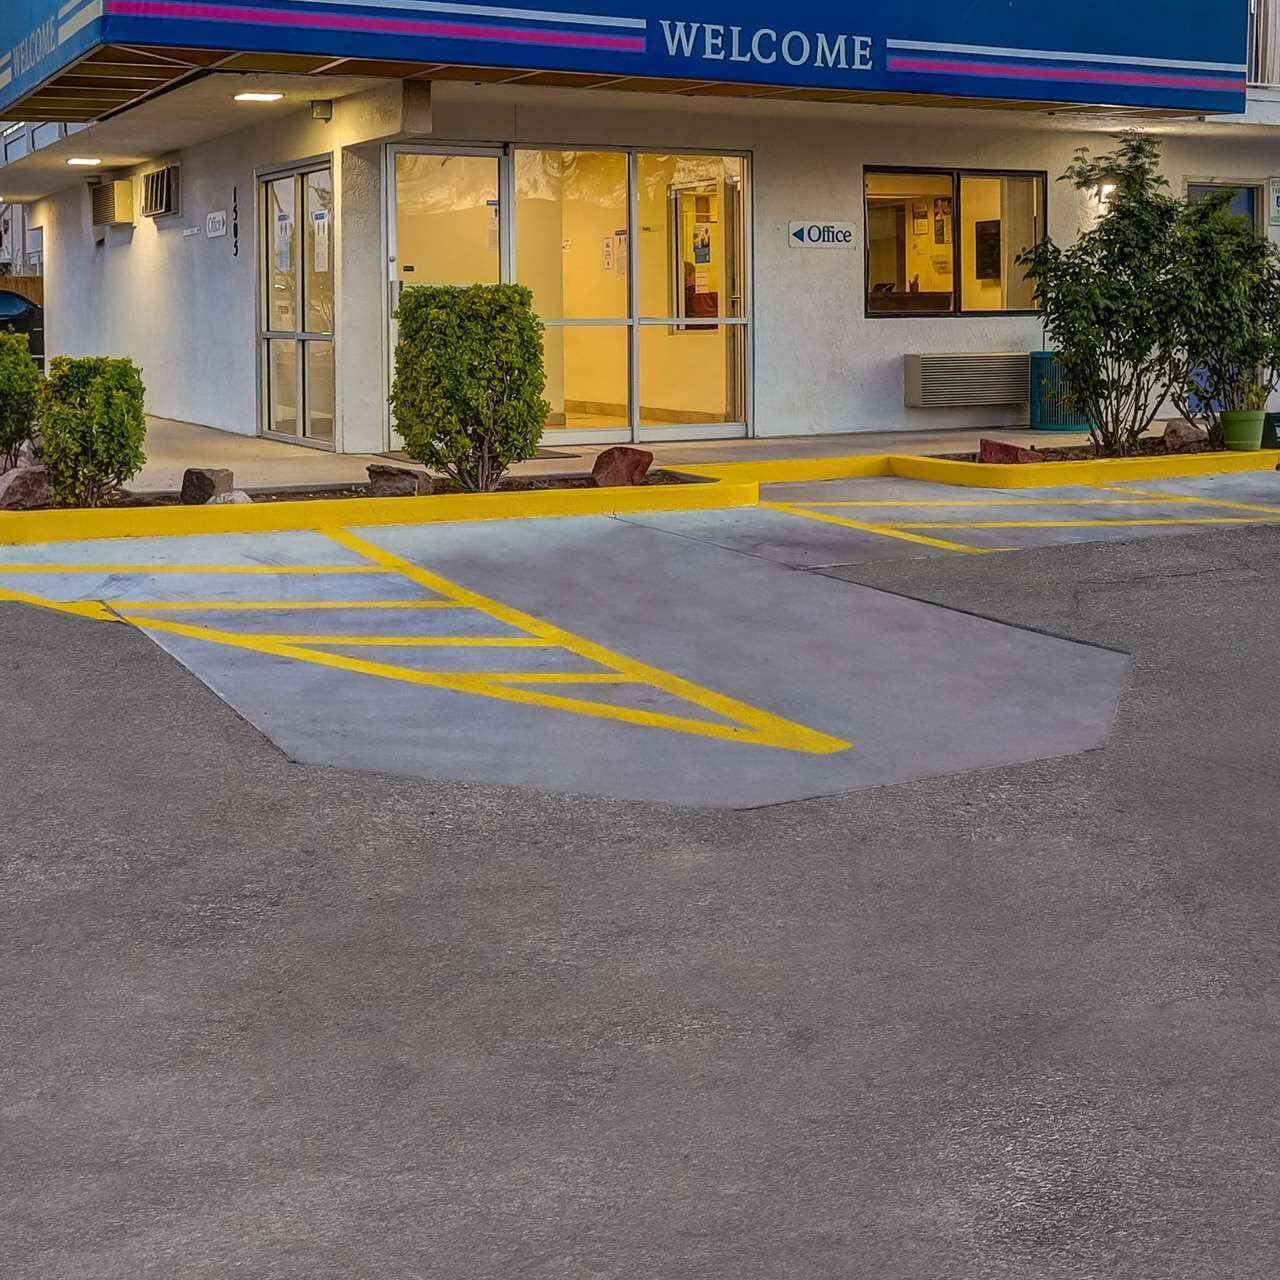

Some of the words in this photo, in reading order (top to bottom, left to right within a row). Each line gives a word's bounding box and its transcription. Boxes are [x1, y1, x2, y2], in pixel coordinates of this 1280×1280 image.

[13, 15, 56, 78] WELCOME
[659, 19, 873, 70] WELCOME
[807, 225, 852, 243] Office
